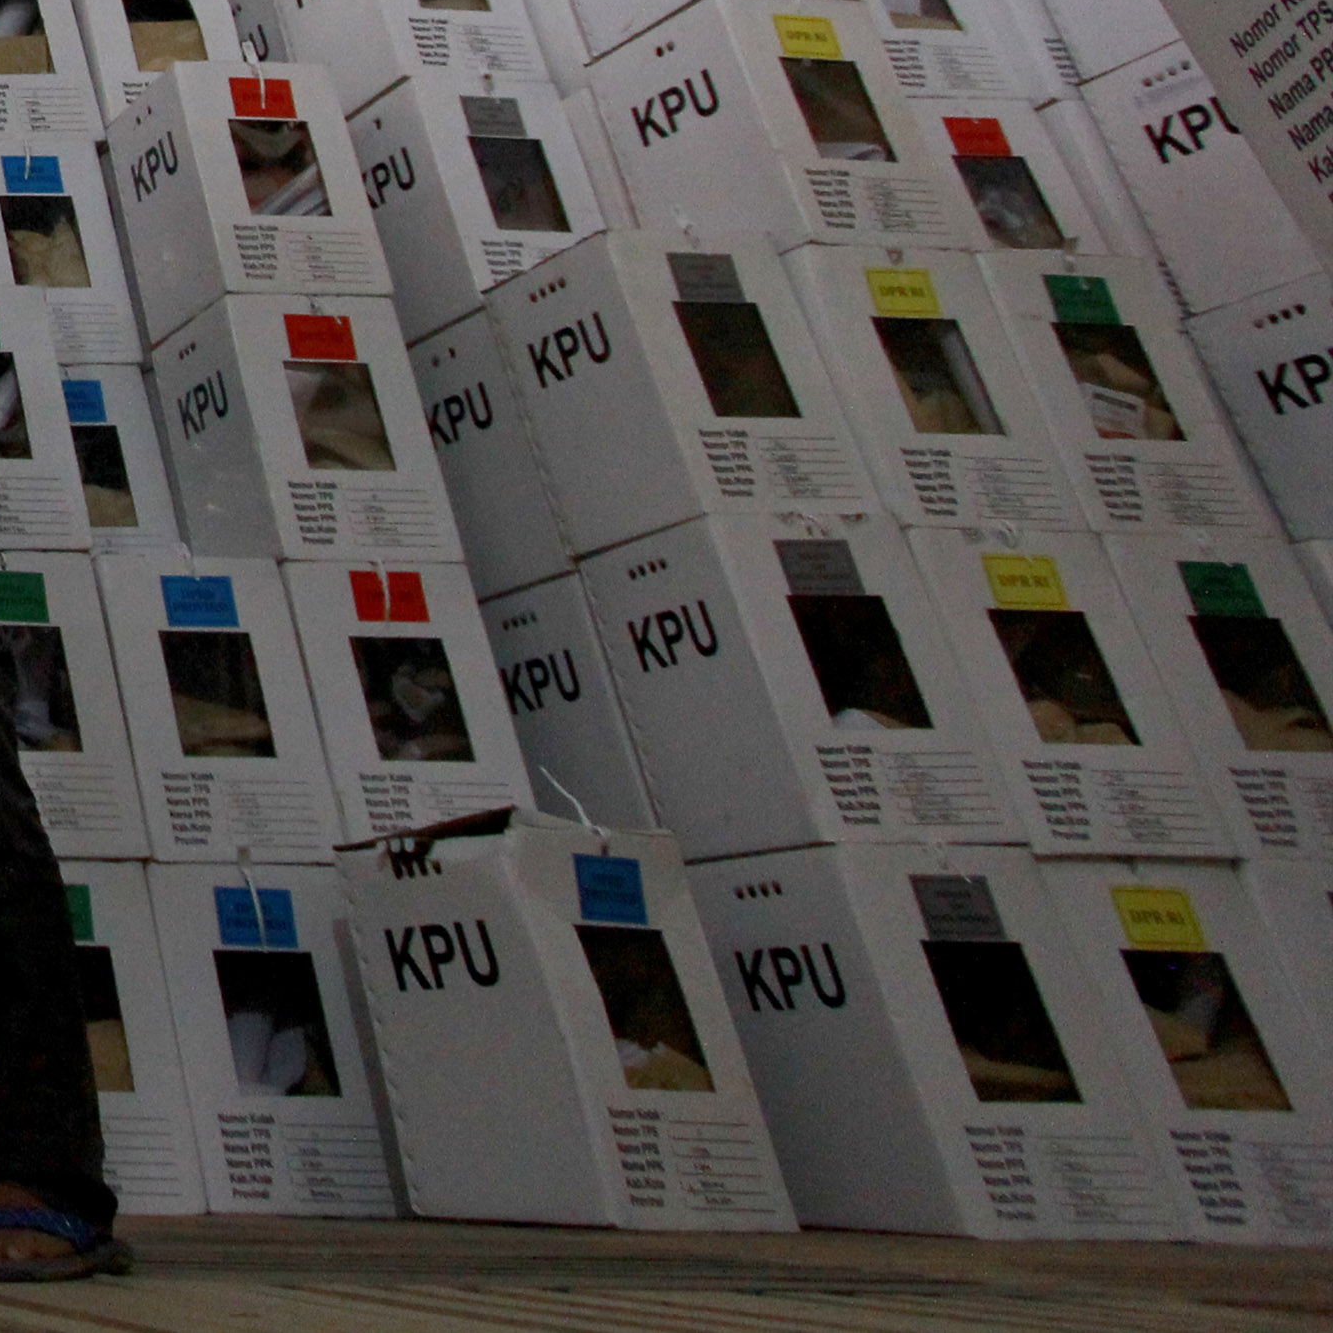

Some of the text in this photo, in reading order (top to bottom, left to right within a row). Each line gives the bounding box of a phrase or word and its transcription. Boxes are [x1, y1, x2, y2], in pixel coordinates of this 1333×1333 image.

[1229, 3, 1282, 58] Nomor
[1248, 1, 1333, 88] Nomor TPS
[631, 69, 720, 147] KPU
[1268, 42, 1333, 119] Nama PP
[130, 131, 180, 201] KPU
[527, 312, 612, 389] KPU
[1256, 347, 1333, 415] KP
[177, 372, 229, 439] KPU
[628, 600, 720, 671] KPU
[501, 649, 581, 714] KPU
[384, 920, 500, 991] KPU
[736, 943, 847, 1012] KPU
